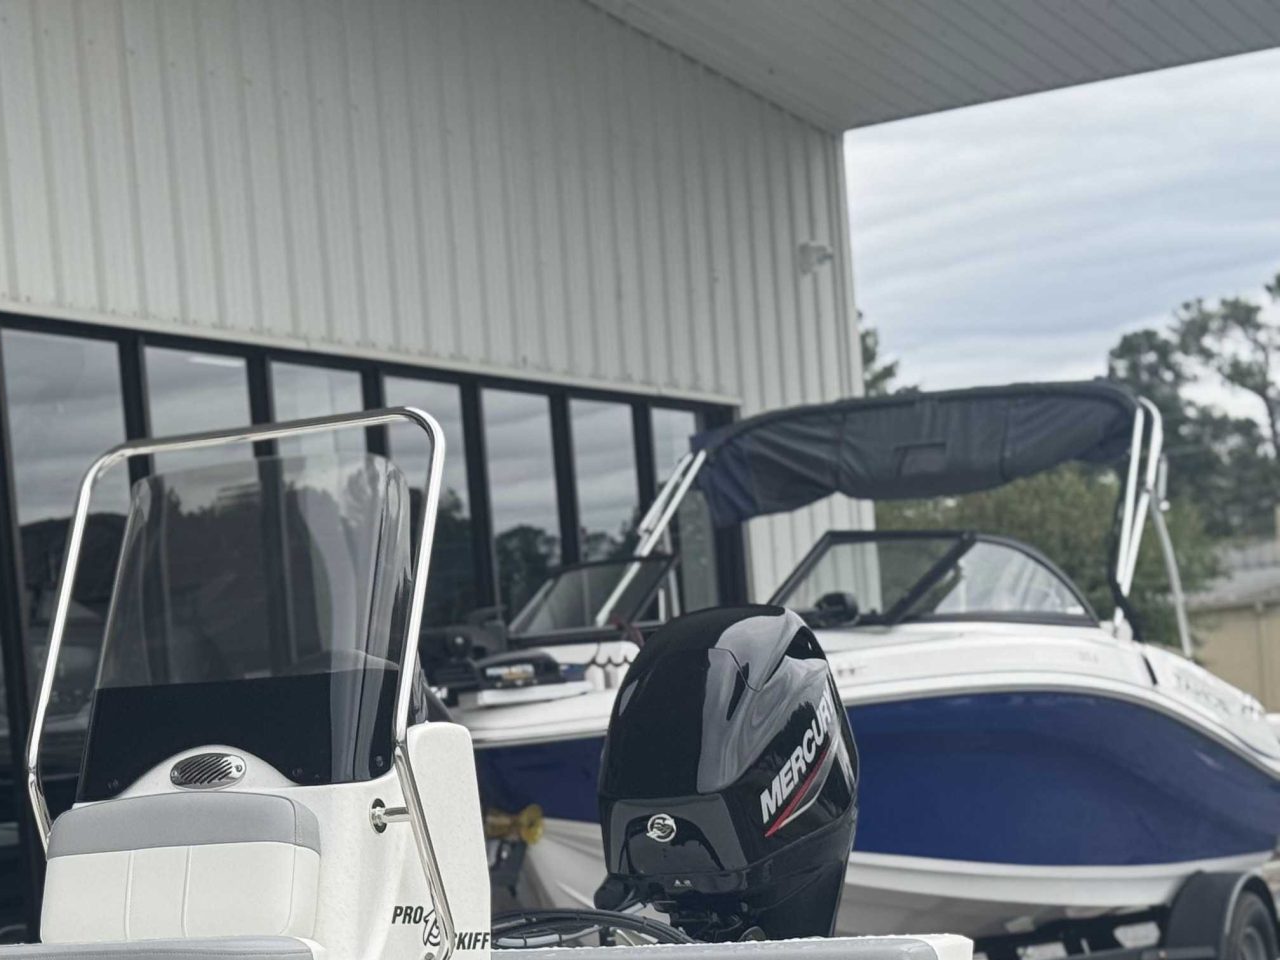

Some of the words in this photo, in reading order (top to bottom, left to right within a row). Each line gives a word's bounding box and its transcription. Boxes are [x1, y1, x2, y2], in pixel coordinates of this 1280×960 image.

[760, 680, 834, 824] MERCURY
[391, 905, 424, 925] PRO
[454, 931, 490, 950] KIFF
